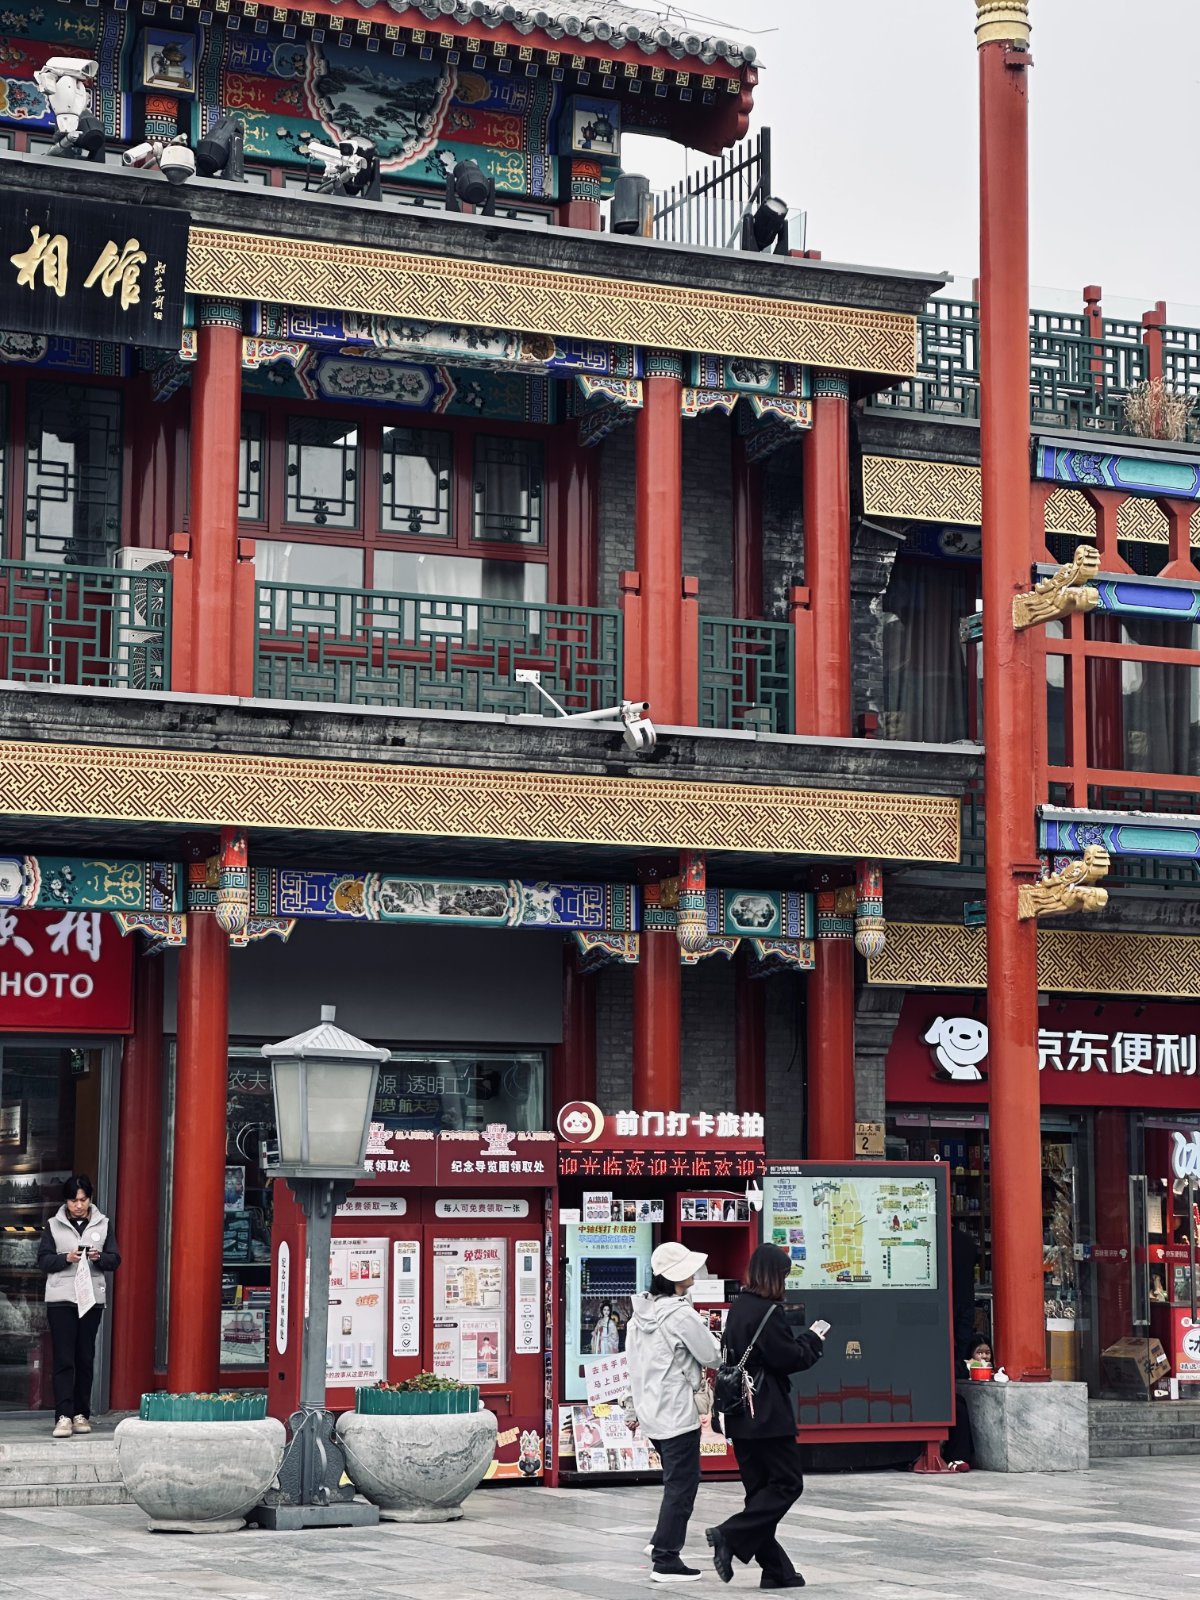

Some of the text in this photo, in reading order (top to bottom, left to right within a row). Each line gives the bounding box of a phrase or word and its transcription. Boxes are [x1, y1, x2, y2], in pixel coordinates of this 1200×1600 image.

[0, 971, 94, 999] HOTO
[227, 1070, 273, 1091] 农夫
[615, 1110, 764, 1137] 前门打卡旅拍
[861, 1136, 869, 1150] 2
[451, 1160, 545, 1173] 纪念导览图领取处
[443, 1204, 521, 1213] 每人可免费领取一张
[463, 1249, 500, 1262] 免费领取
